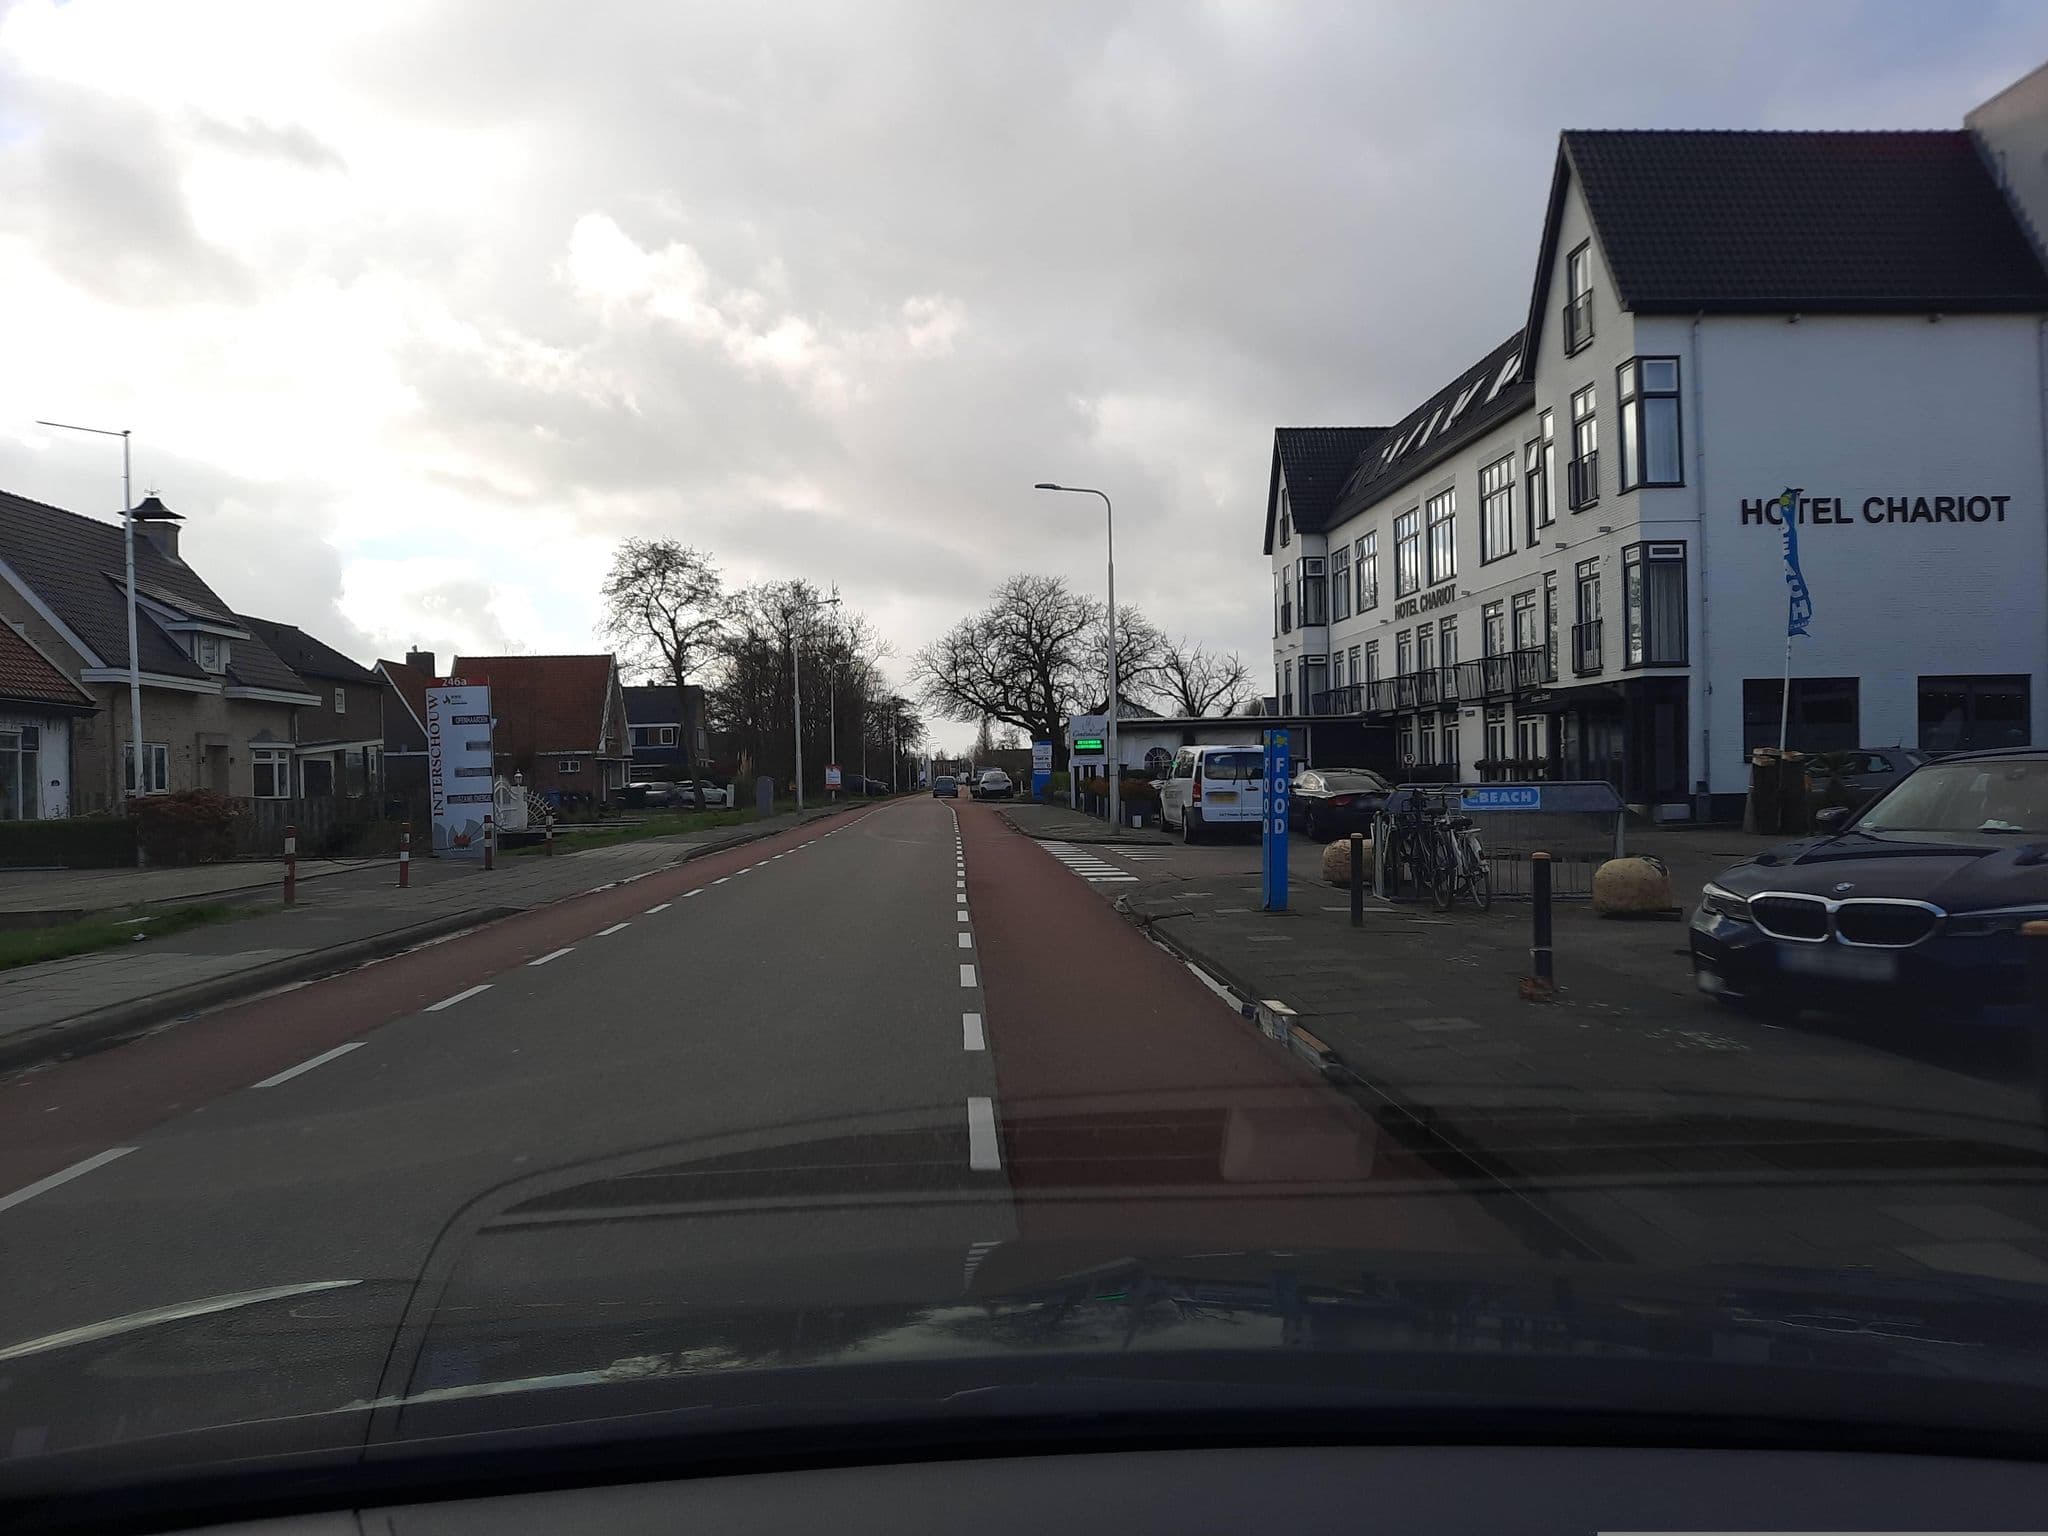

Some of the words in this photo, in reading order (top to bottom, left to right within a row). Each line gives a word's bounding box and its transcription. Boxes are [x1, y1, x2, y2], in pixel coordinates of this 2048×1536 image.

[1741, 498, 1854, 525] HOTEL
[1863, 495, 2011, 523] CHARIOT
[1394, 598, 1419, 620] HOTEL
[1420, 583, 1457, 613] CHARIOT
[441, 677, 467, 687] 246a
[428, 695, 444, 817] INTERSCHOUW
[1273, 757, 1286, 835] FOOD
[1479, 791, 1532, 803] BEACH
